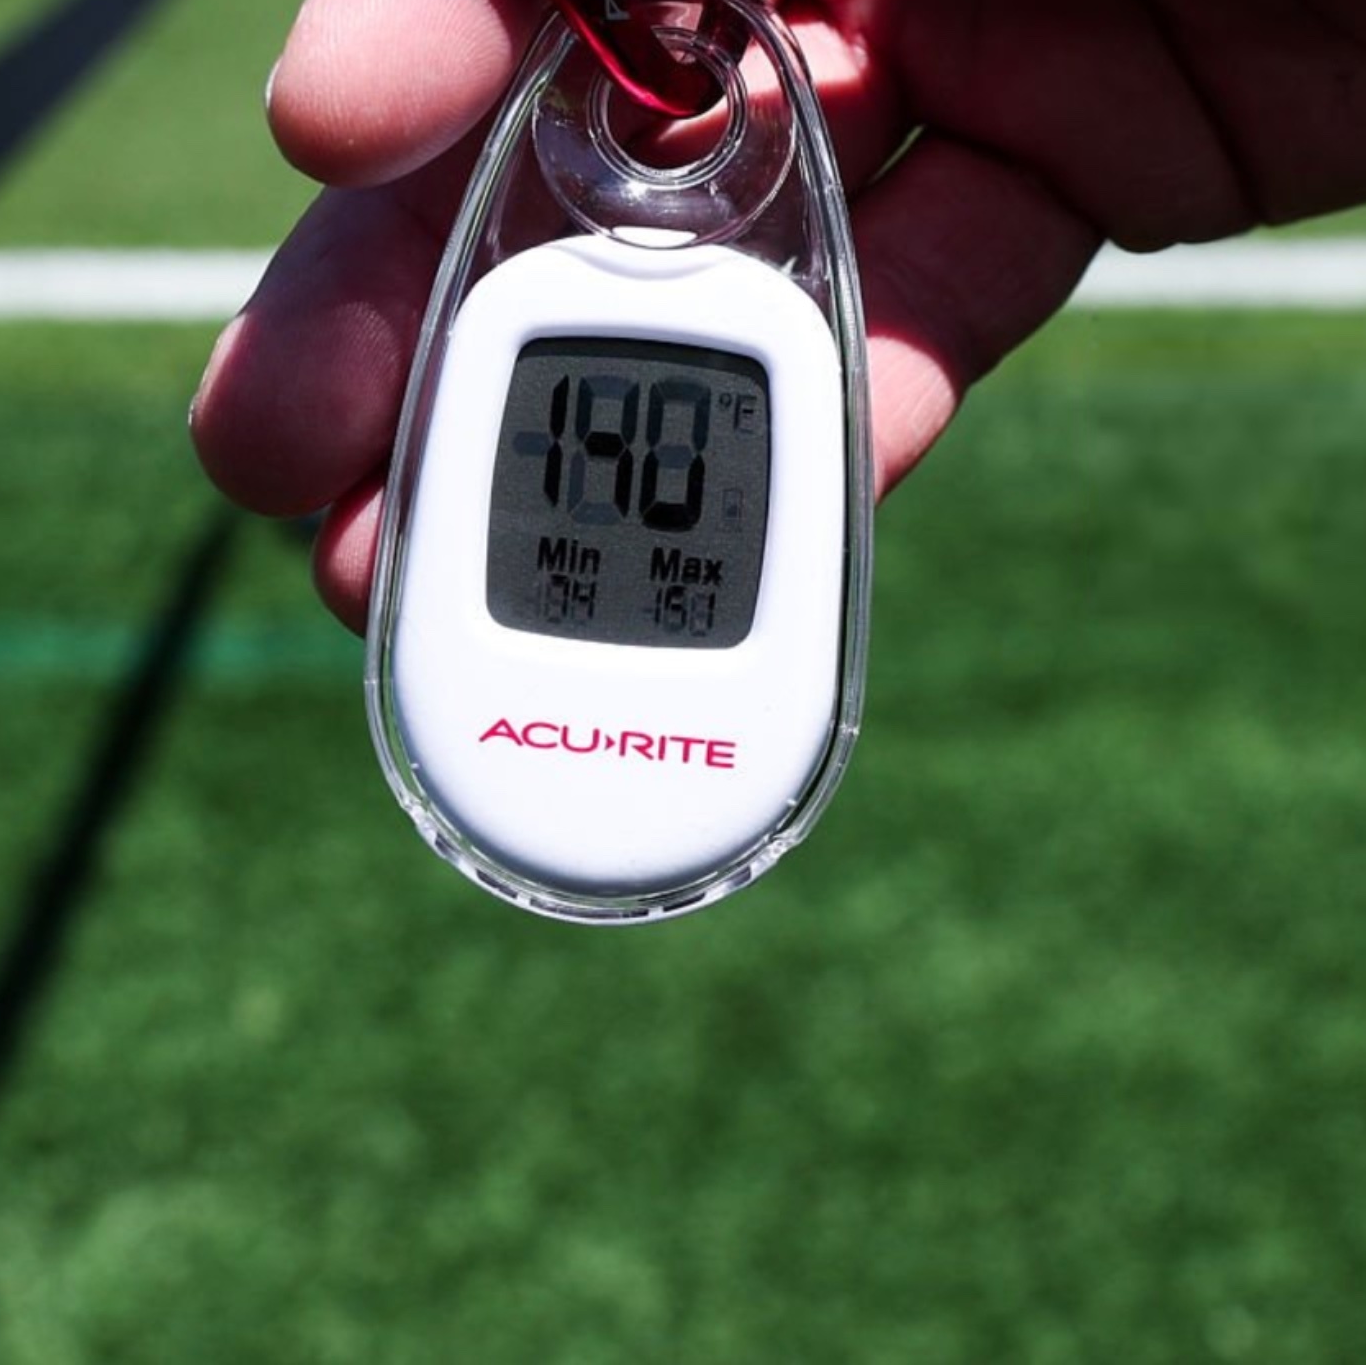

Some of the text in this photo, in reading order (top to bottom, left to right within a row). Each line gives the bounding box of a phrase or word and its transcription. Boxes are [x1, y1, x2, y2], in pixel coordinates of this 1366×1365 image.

[543, 374, 712, 533] 140
[537, 536, 724, 587] Min Max
[549, 575, 597, 620] 74
